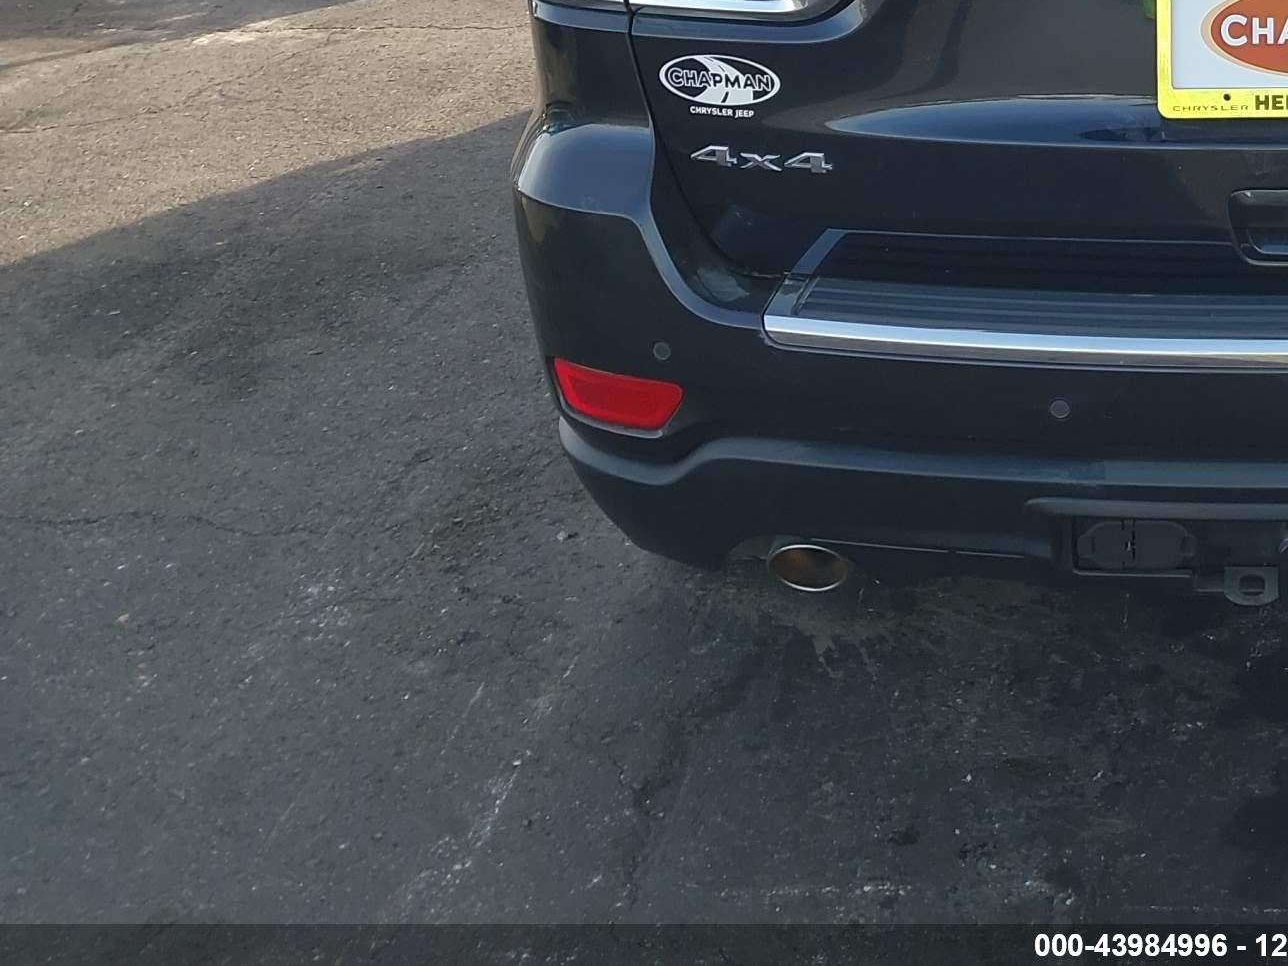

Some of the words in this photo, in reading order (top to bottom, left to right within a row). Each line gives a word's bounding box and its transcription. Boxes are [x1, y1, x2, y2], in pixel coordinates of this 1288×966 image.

[667, 67, 773, 92] CHAPMAN
[689, 106, 733, 117] CHRYSLER
[735, 109, 755, 119] JEEP
[1172, 104, 1249, 112] CHRYSLER
